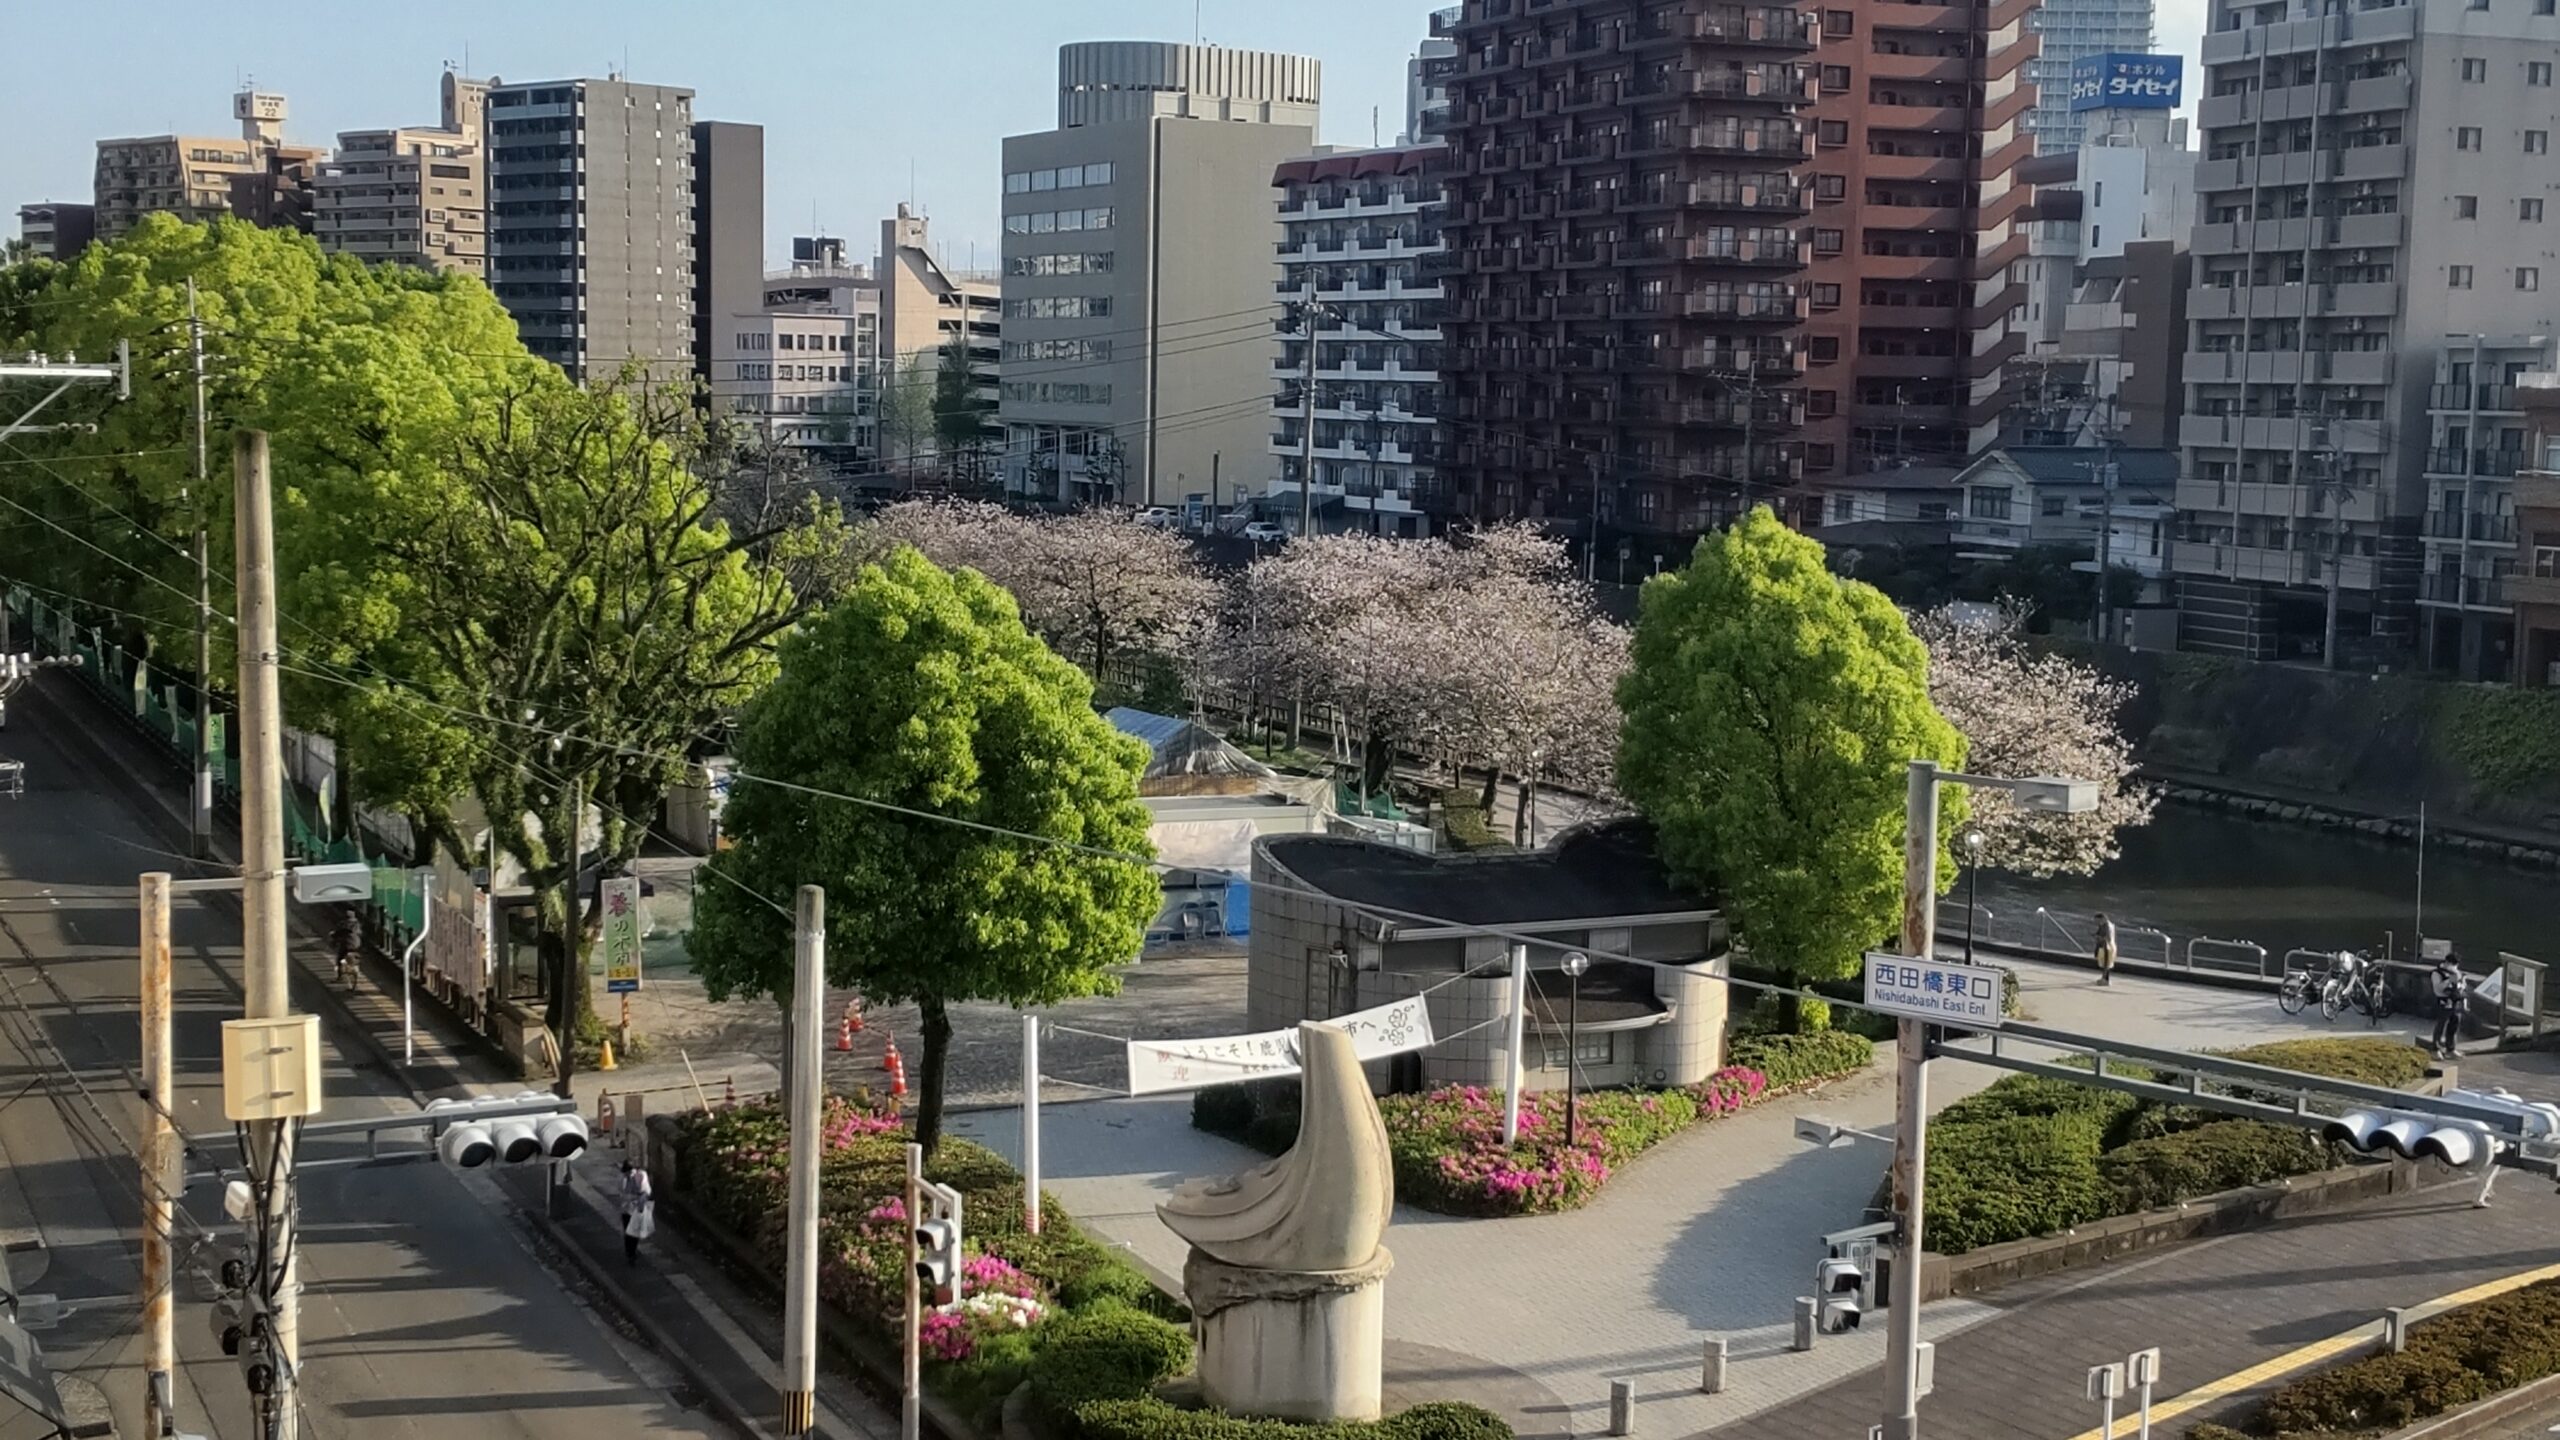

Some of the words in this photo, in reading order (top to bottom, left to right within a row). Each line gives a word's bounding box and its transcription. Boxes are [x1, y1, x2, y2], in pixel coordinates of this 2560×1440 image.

[2072, 77, 2103, 100] タイセイ
[2108, 77, 2179, 95] タイセイ
[1875, 962, 1991, 1000] 西田橋東口
[1874, 988, 1940, 1009] Nishidabashi
[1943, 997, 1966, 1013] East
[1969, 1001, 1986, 1016] Ent
